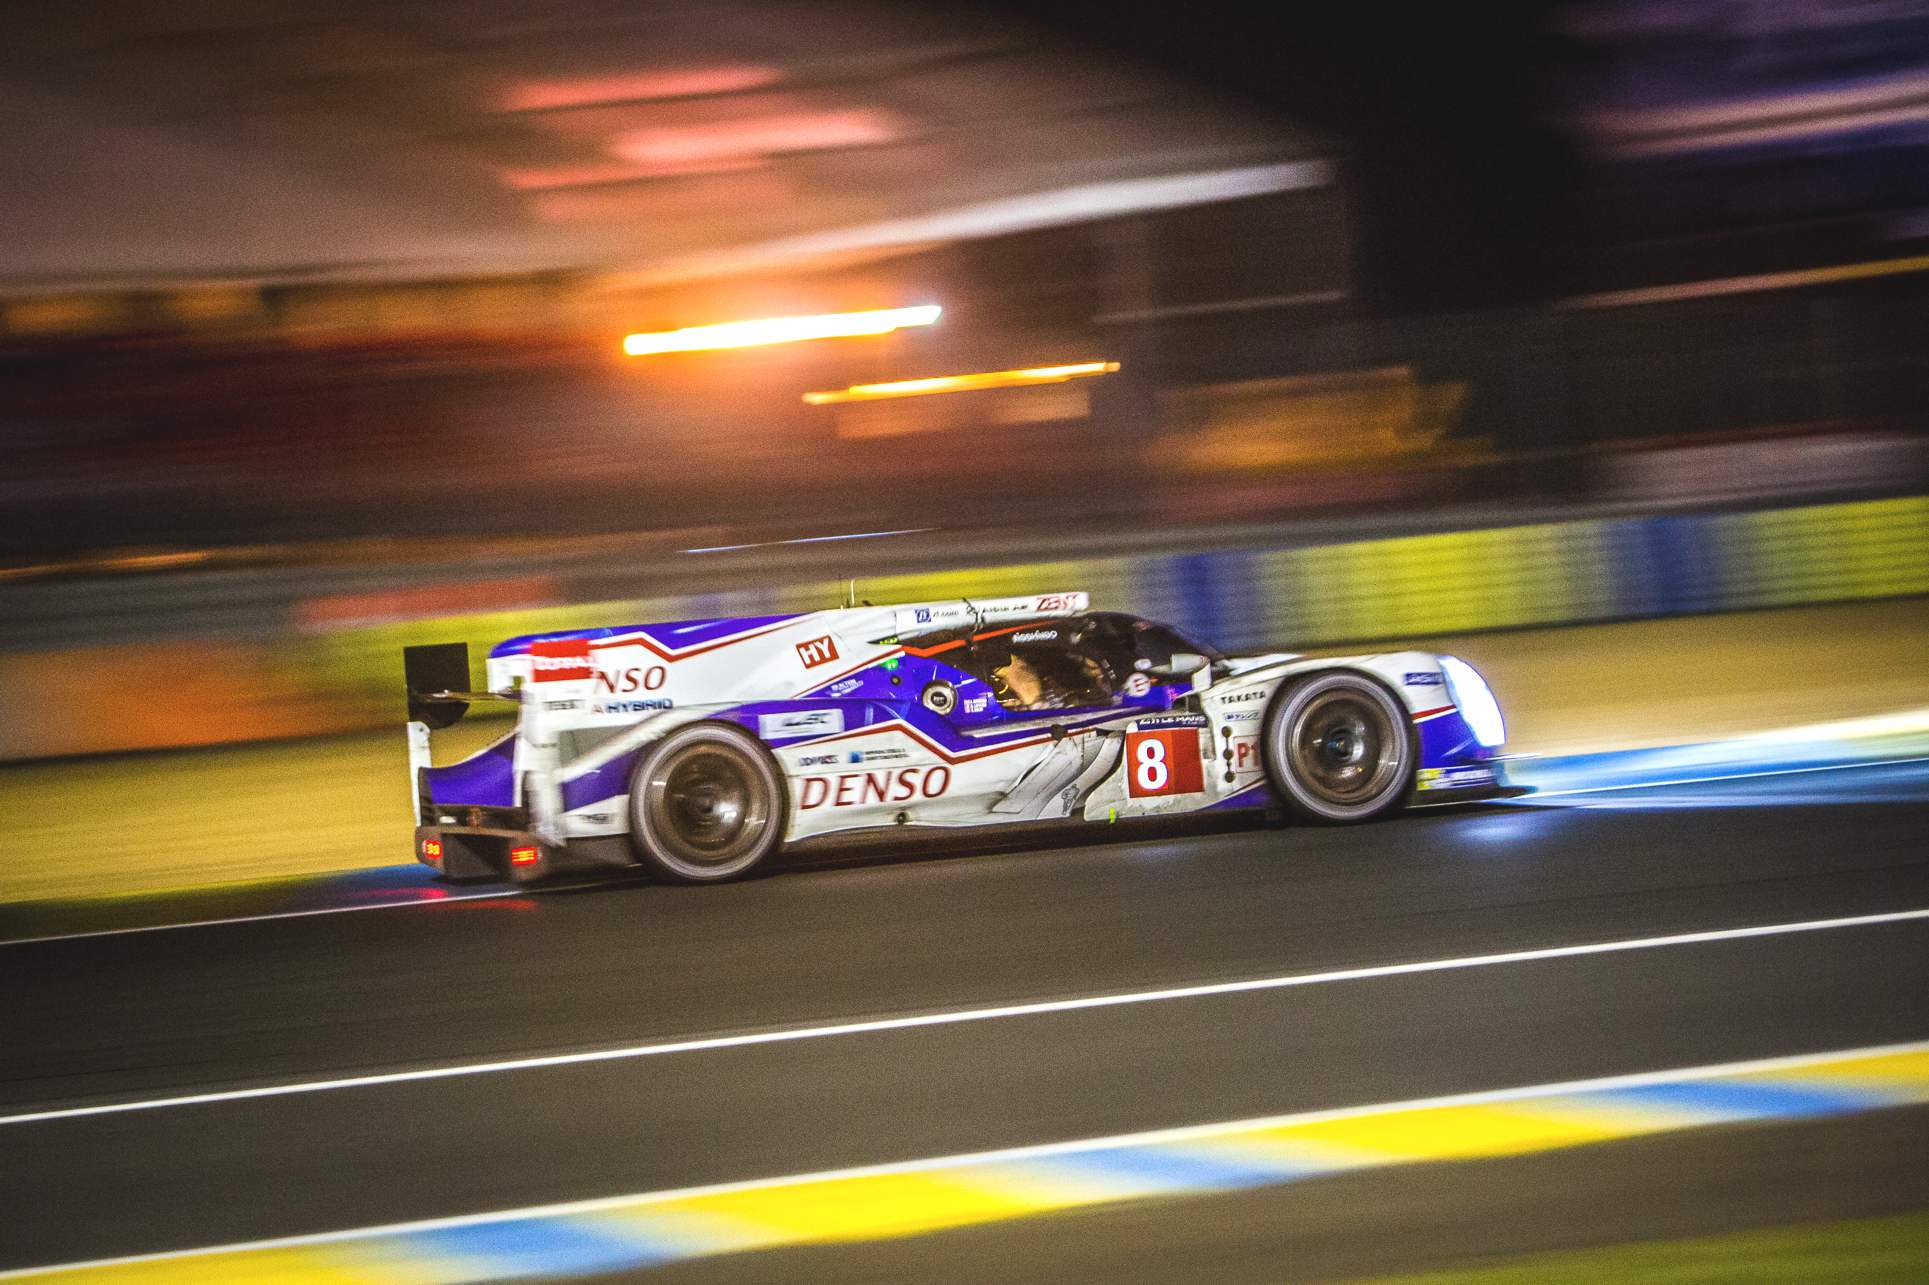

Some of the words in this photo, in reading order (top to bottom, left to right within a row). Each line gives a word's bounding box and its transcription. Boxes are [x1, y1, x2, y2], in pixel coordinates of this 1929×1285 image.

[799, 637, 835, 665] HY
[1220, 690, 1267, 705] TAKATA
[1137, 738, 1168, 791] 8
[799, 765, 952, 810] DENSO
